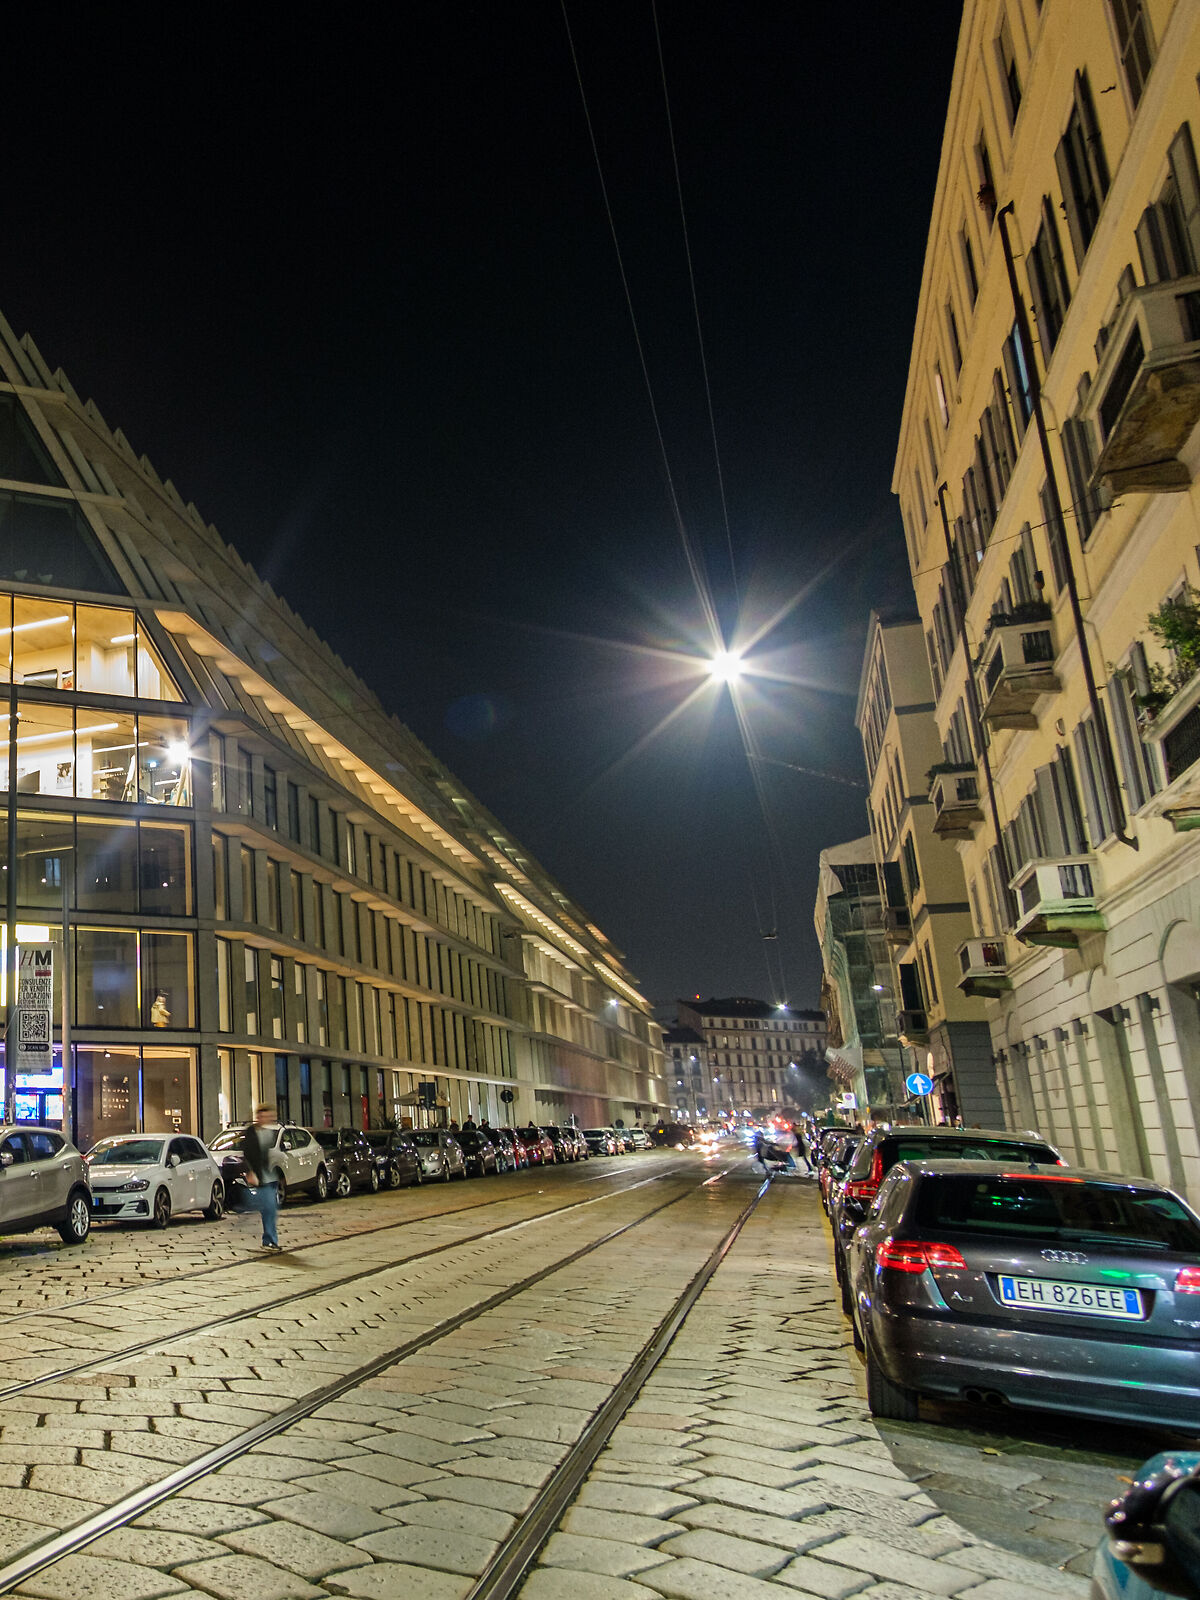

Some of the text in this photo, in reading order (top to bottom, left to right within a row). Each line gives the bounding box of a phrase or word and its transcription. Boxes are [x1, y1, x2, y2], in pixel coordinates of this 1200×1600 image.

[29, 985, 52, 993] VENDITE
[22, 992, 52, 1000] LOCAZIONI
[1017, 1281, 1124, 1309] EH 826EE
